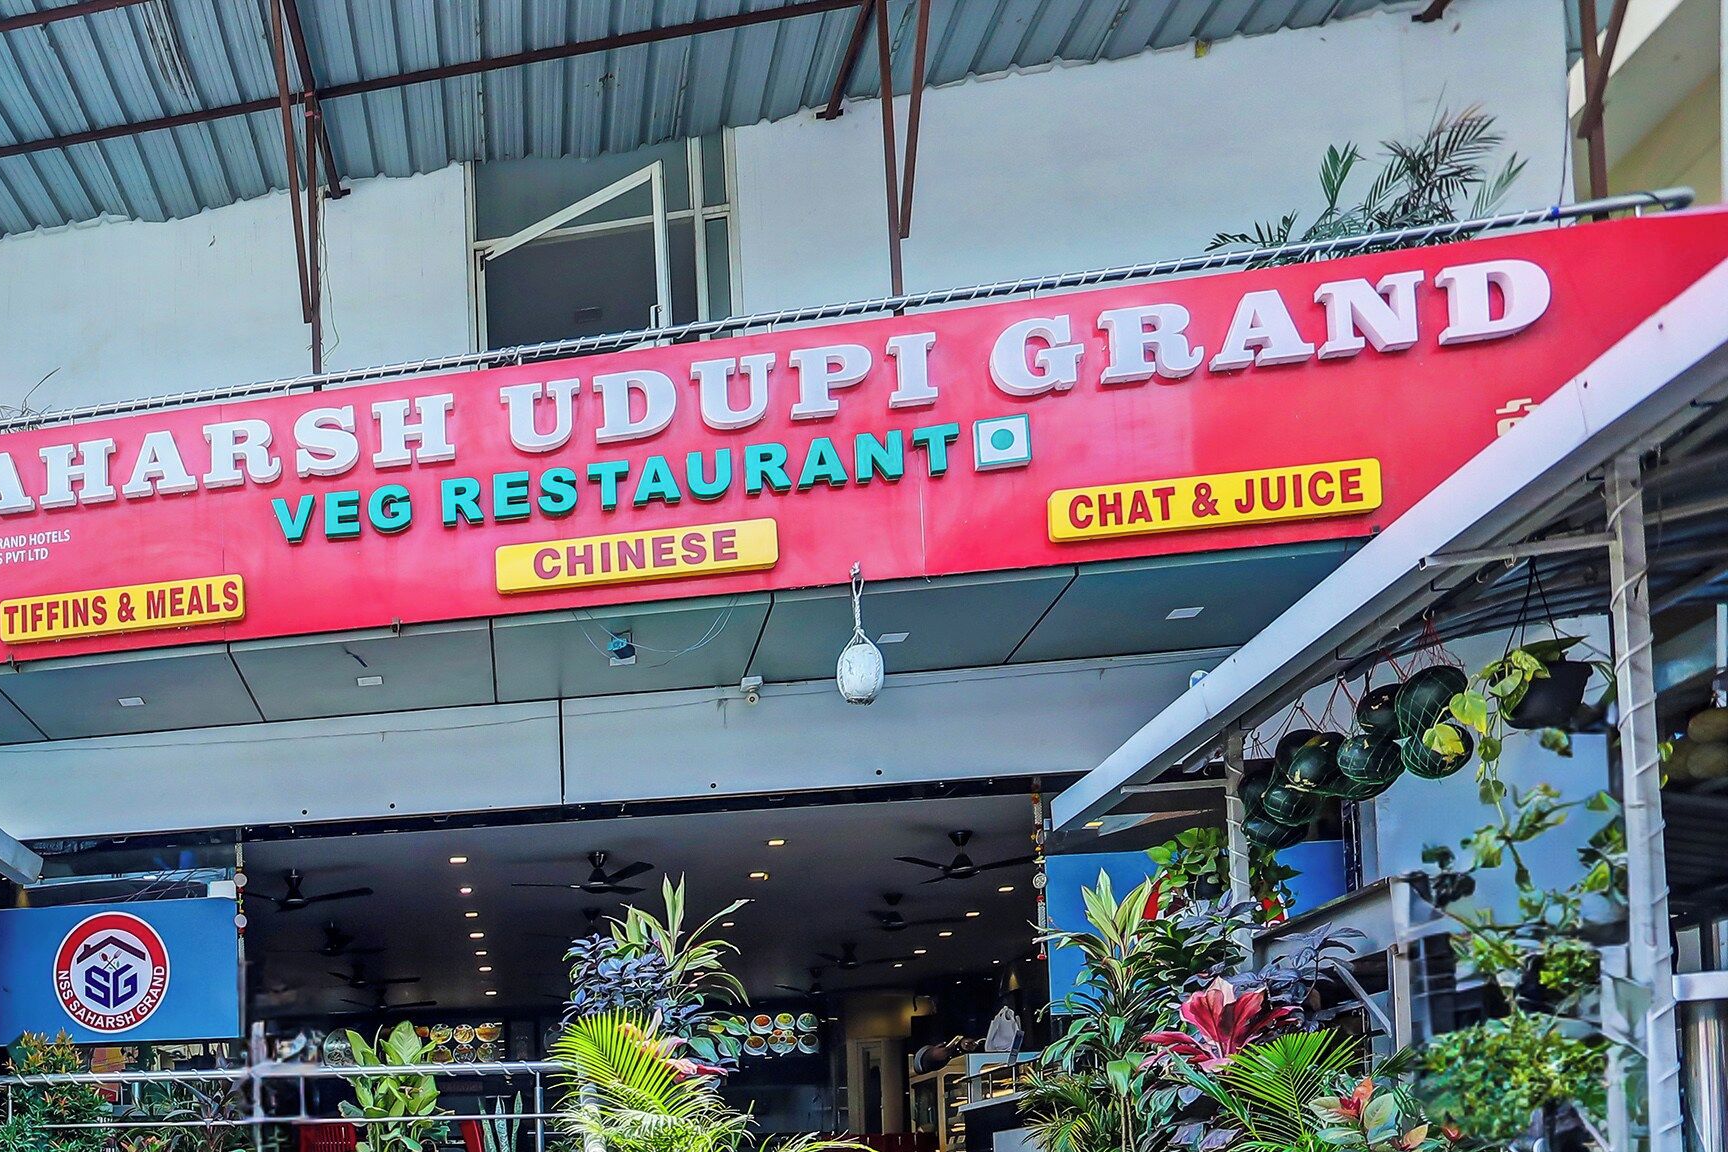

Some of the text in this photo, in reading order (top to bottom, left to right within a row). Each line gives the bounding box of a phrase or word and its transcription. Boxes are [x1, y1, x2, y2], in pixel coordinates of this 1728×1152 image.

[498, 330, 939, 453] UDUPI
[988, 257, 1552, 397] GRAND
[272, 421, 959, 543] VEG RESTAURANT
[1069, 467, 1363, 529] CHAT & JUICE
[5, 550, 27, 566] PVT
[28, 547, 49, 562] LTD
[29, 529, 71, 548] HOTELS
[532, 527, 738, 583] CHINESE
[3, 582, 240, 637] TIFFINS & MEALS
[58, 965, 165, 1028] NSS SAHARSH GRAND
